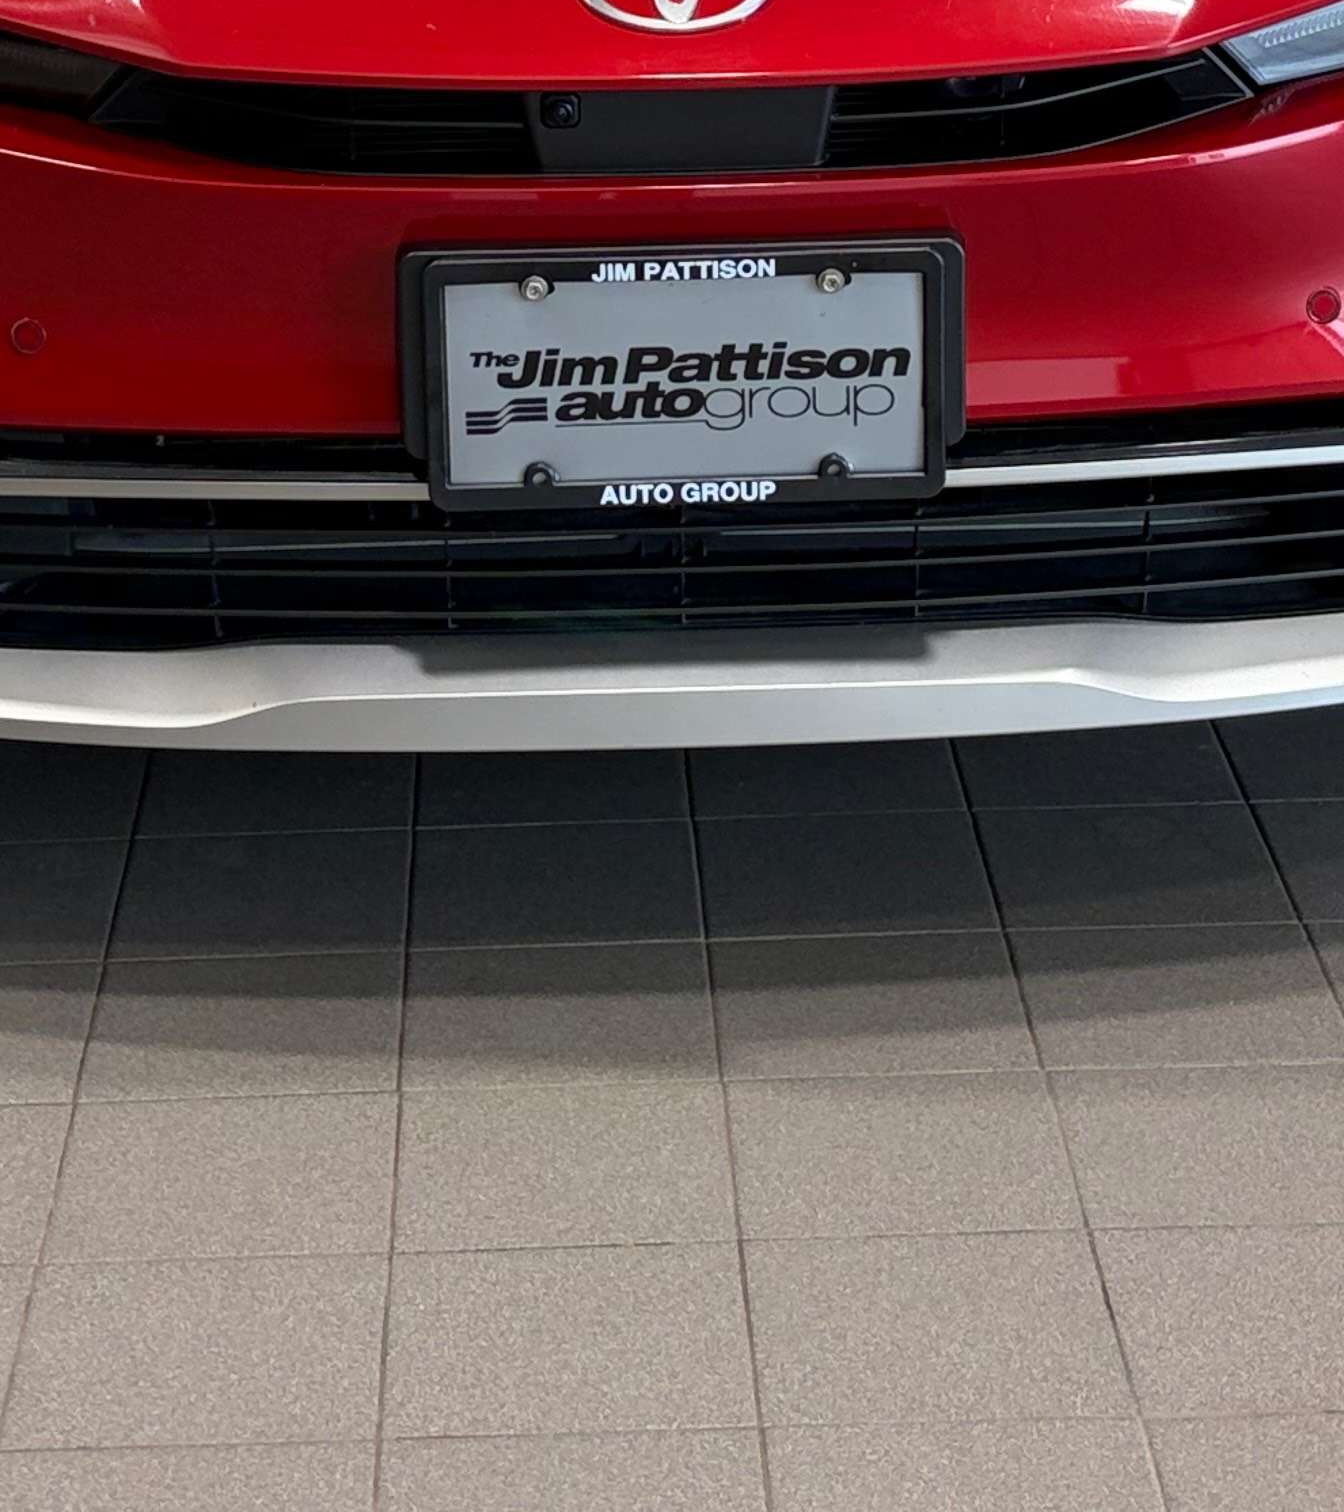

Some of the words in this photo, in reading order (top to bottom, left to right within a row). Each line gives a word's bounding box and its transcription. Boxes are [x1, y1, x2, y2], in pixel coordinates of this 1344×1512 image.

[591, 262, 636, 283] JIM
[644, 258, 776, 281] PATTISON
[469, 351, 520, 368] The
[496, 348, 619, 389] Jim
[623, 341, 911, 385] Pattison
[600, 483, 674, 506] AUTO
[680, 480, 777, 503] GROUP
